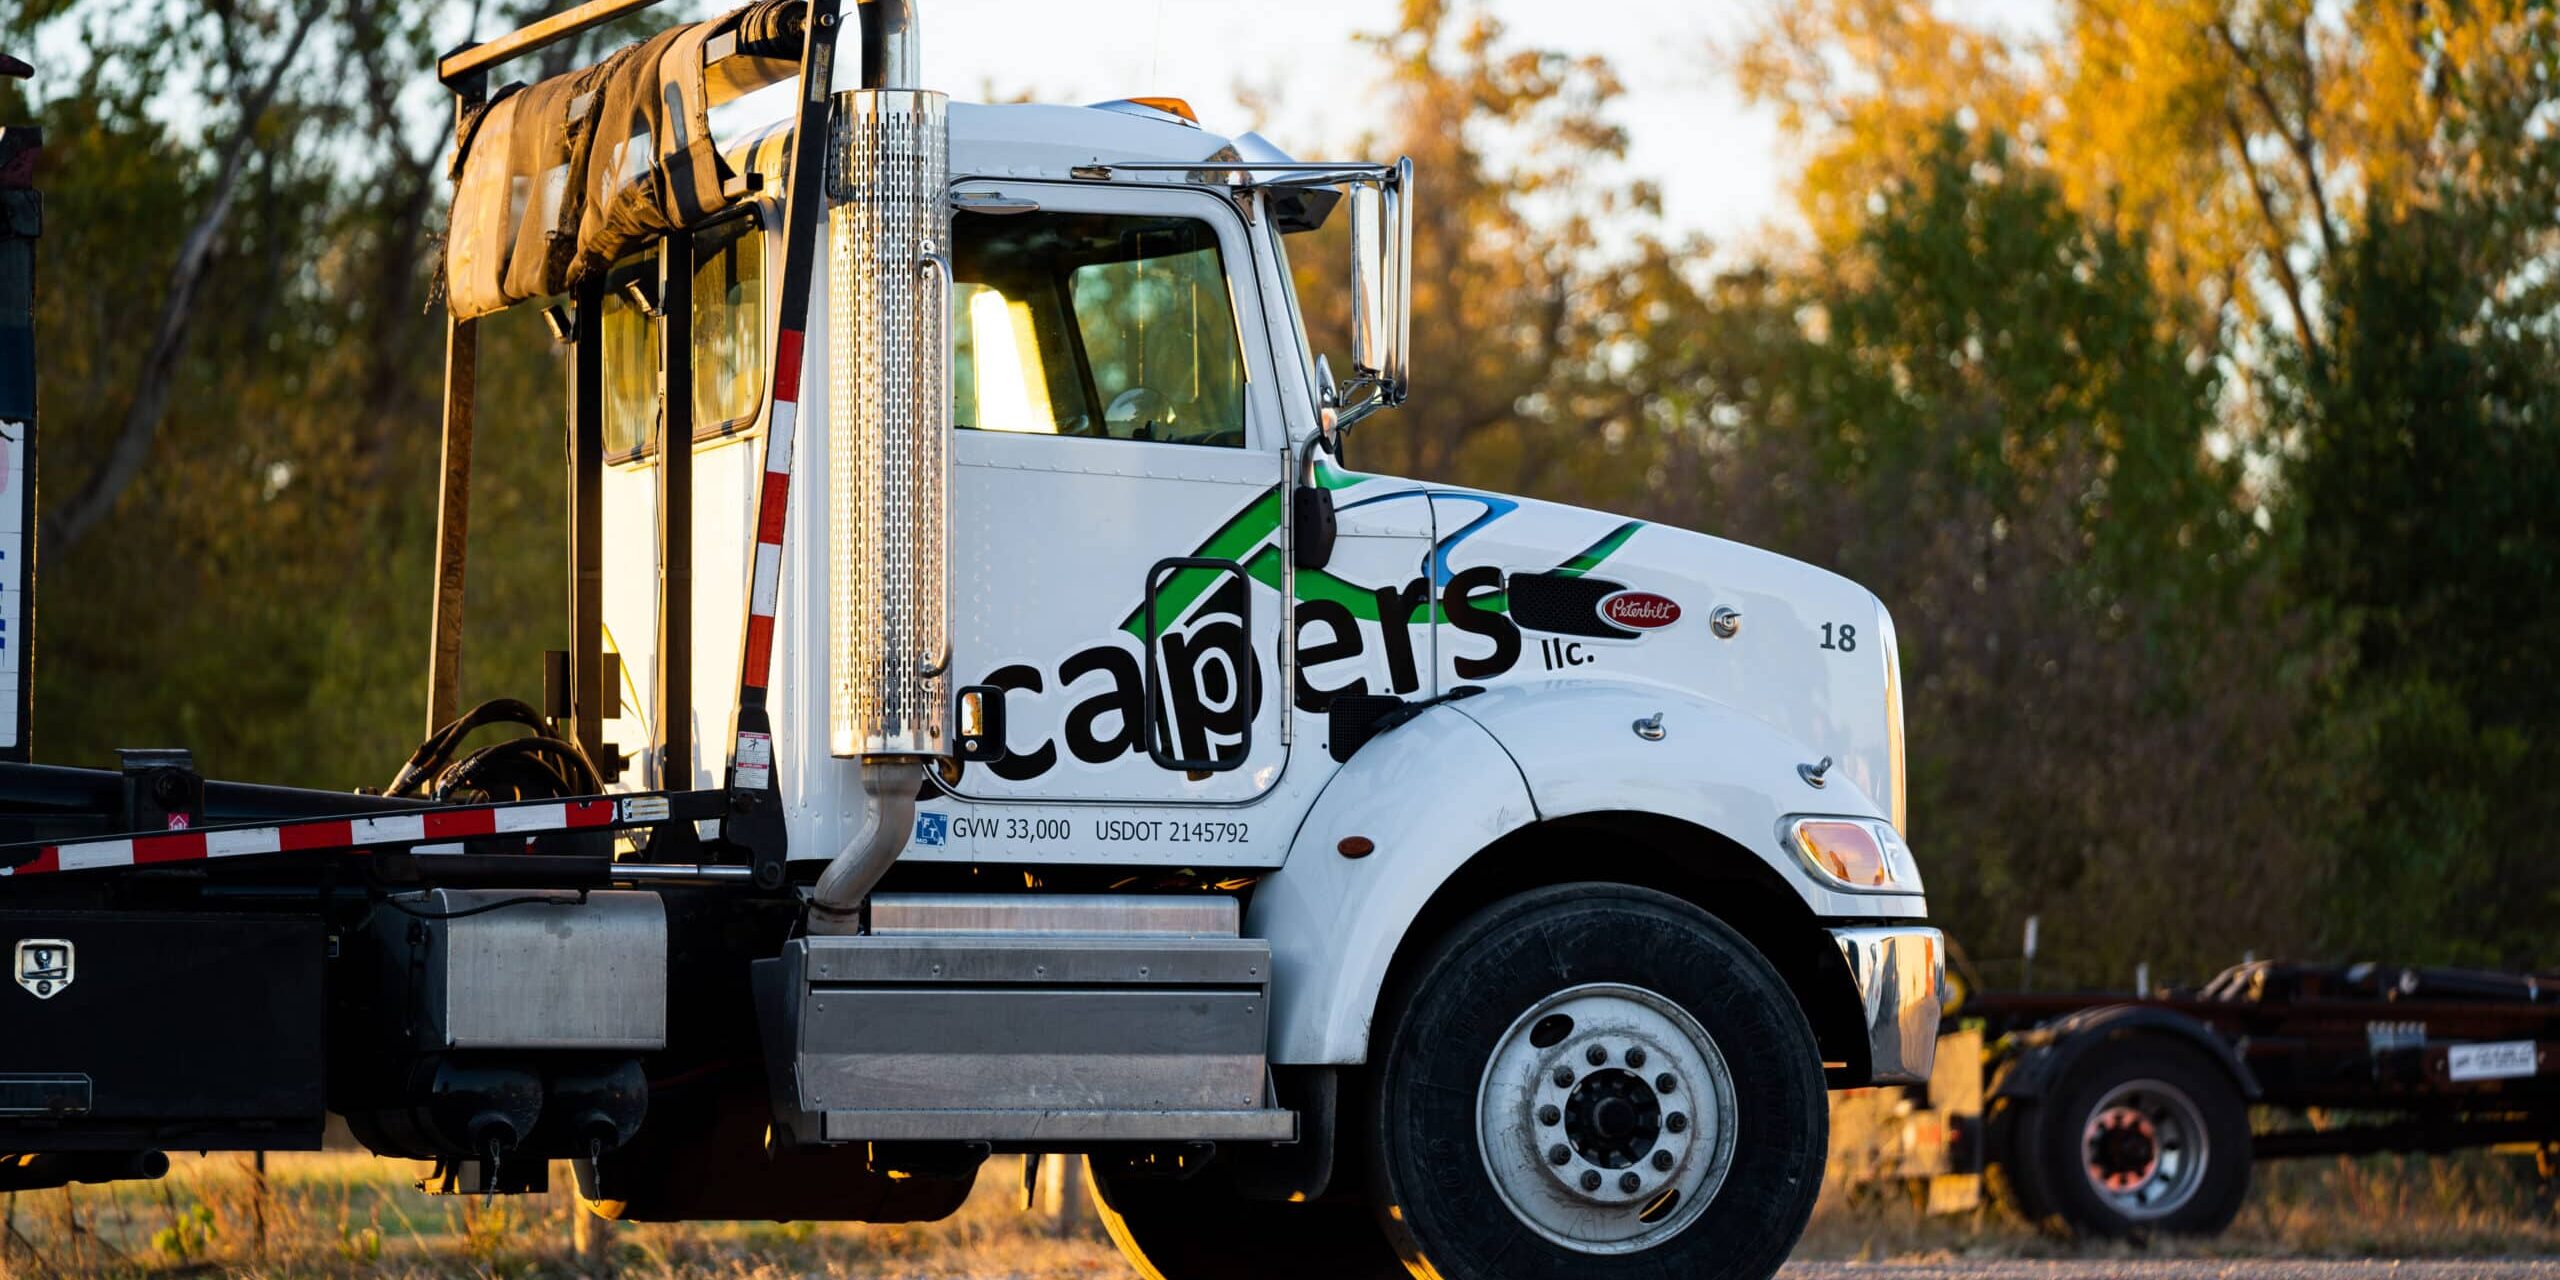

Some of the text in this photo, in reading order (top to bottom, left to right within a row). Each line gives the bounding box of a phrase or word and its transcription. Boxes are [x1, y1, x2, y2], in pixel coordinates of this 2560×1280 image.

[1612, 597, 1676, 619] Peterbilt
[1819, 622, 1857, 652] 18
[914, 566, 1522, 801] capers
[952, 817, 1249, 843] GVW 33,000 USDOT 2145792
